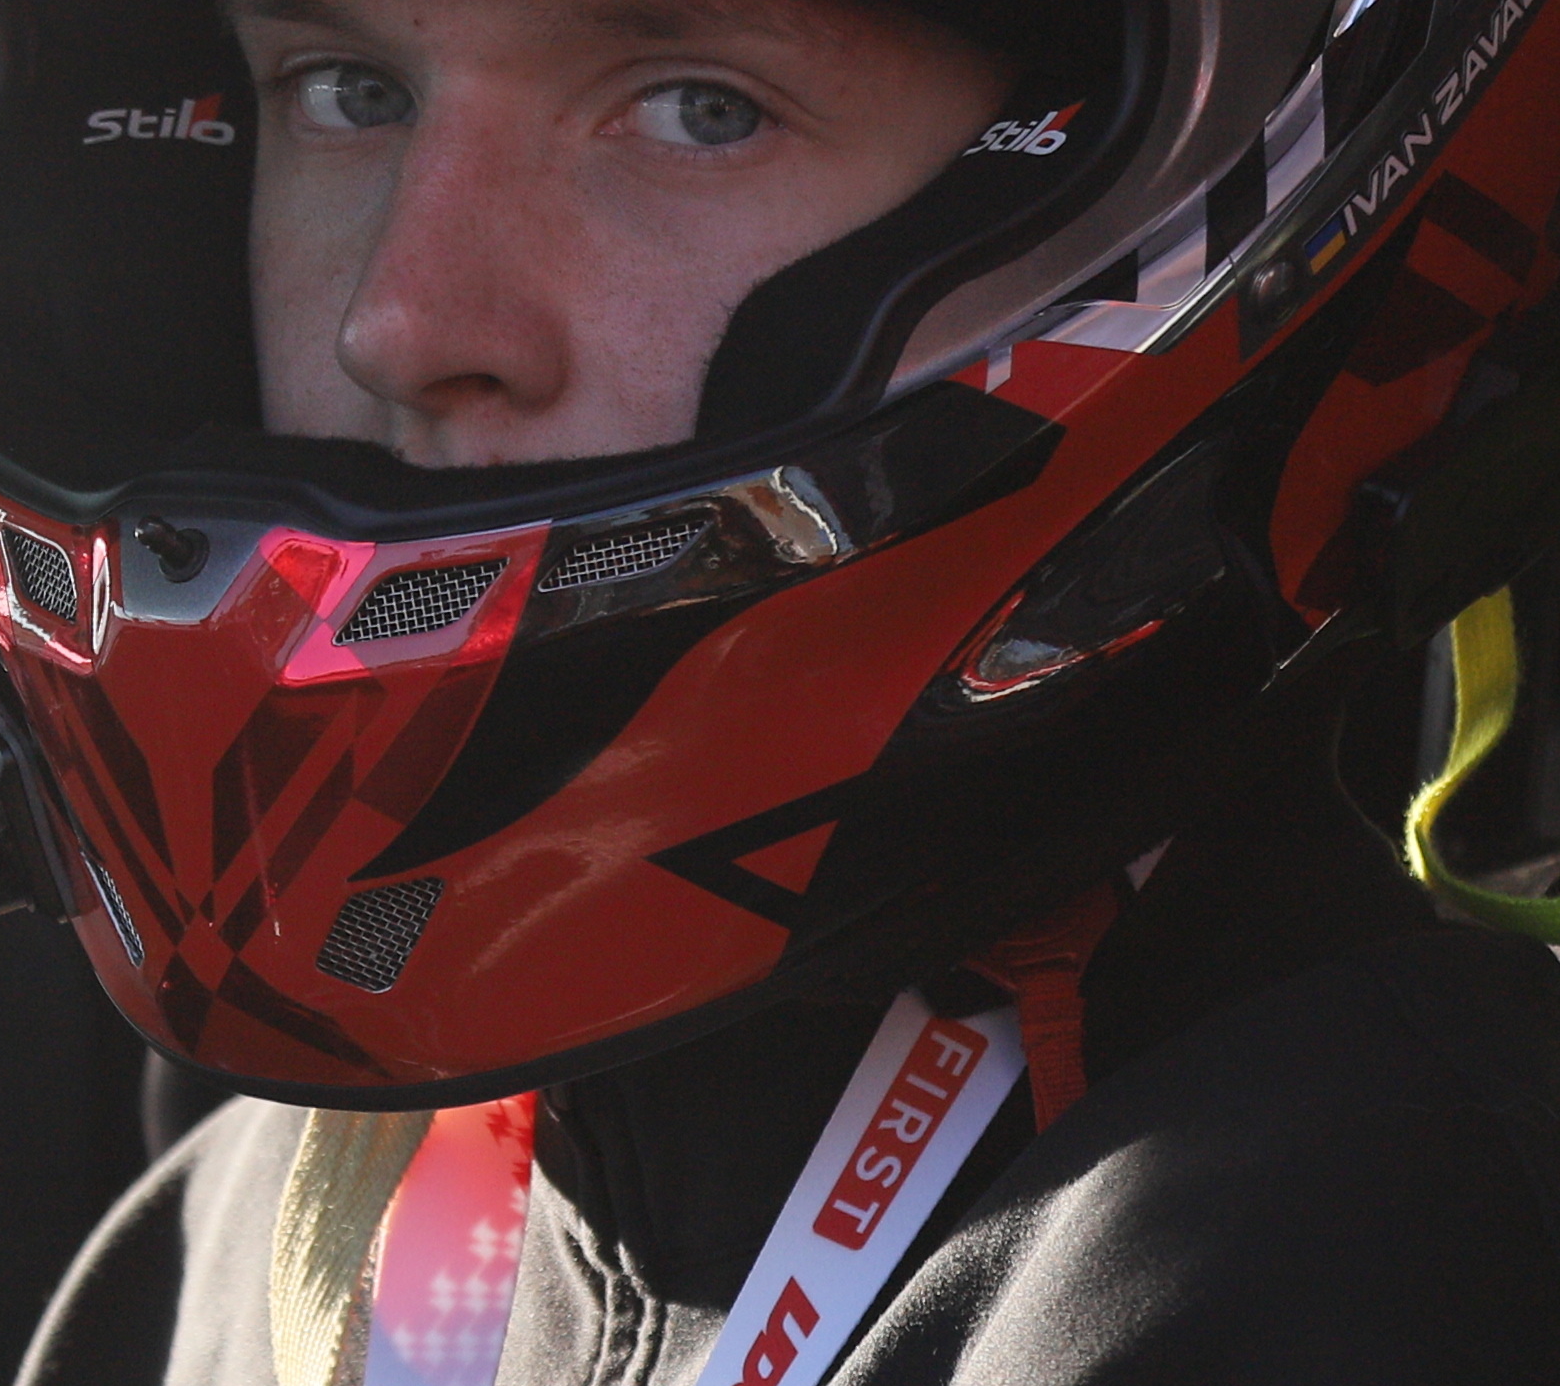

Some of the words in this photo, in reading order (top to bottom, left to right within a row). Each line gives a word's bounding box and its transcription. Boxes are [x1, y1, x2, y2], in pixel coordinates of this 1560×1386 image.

[83, 97, 236, 146] Stilo
[961, 110, 1069, 157] Stilo
[1342, 112, 1434, 238] IVAN
[832, 1029, 975, 1236] FIRST
